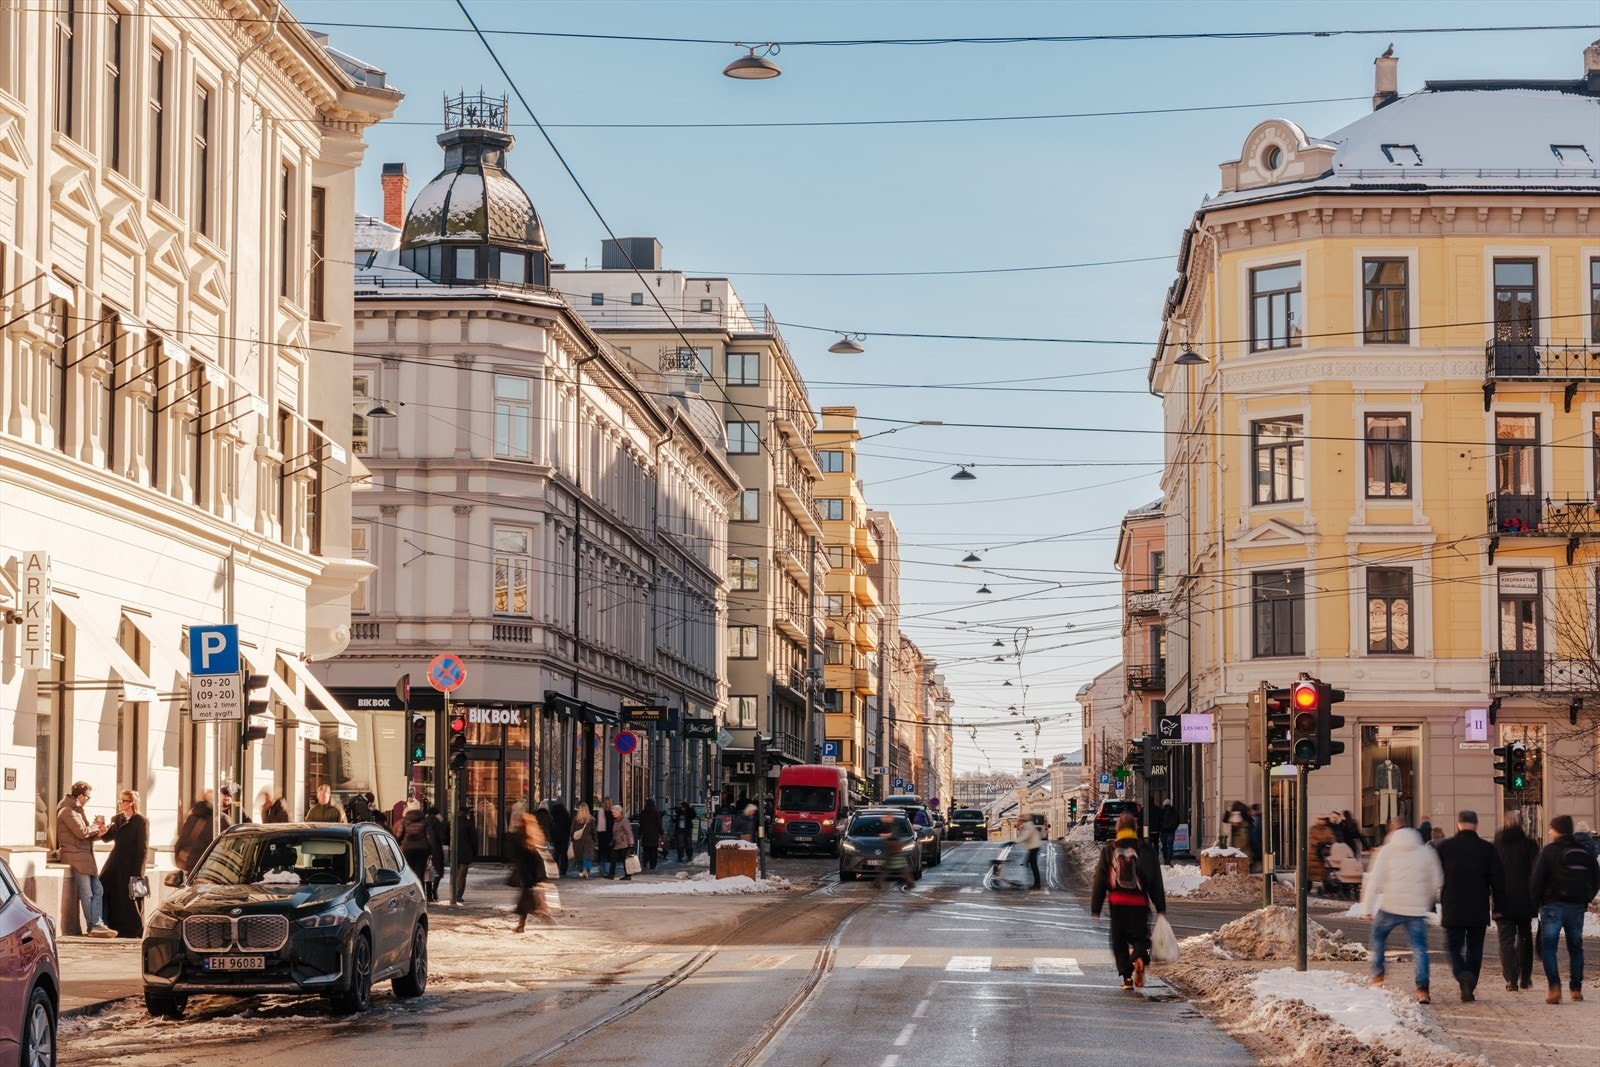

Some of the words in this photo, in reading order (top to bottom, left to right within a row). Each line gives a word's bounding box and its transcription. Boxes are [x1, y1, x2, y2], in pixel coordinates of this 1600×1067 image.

[25, 553, 42, 666] ARKET
[201, 631, 227, 669] P
[200, 678, 231, 687] 09-20
[197, 690, 235, 700] (09-20)
[214, 709, 233, 718] avgift
[825, 743, 833, 755] P
[211, 958, 225, 968] EH
[230, 957, 263, 968] 96082
